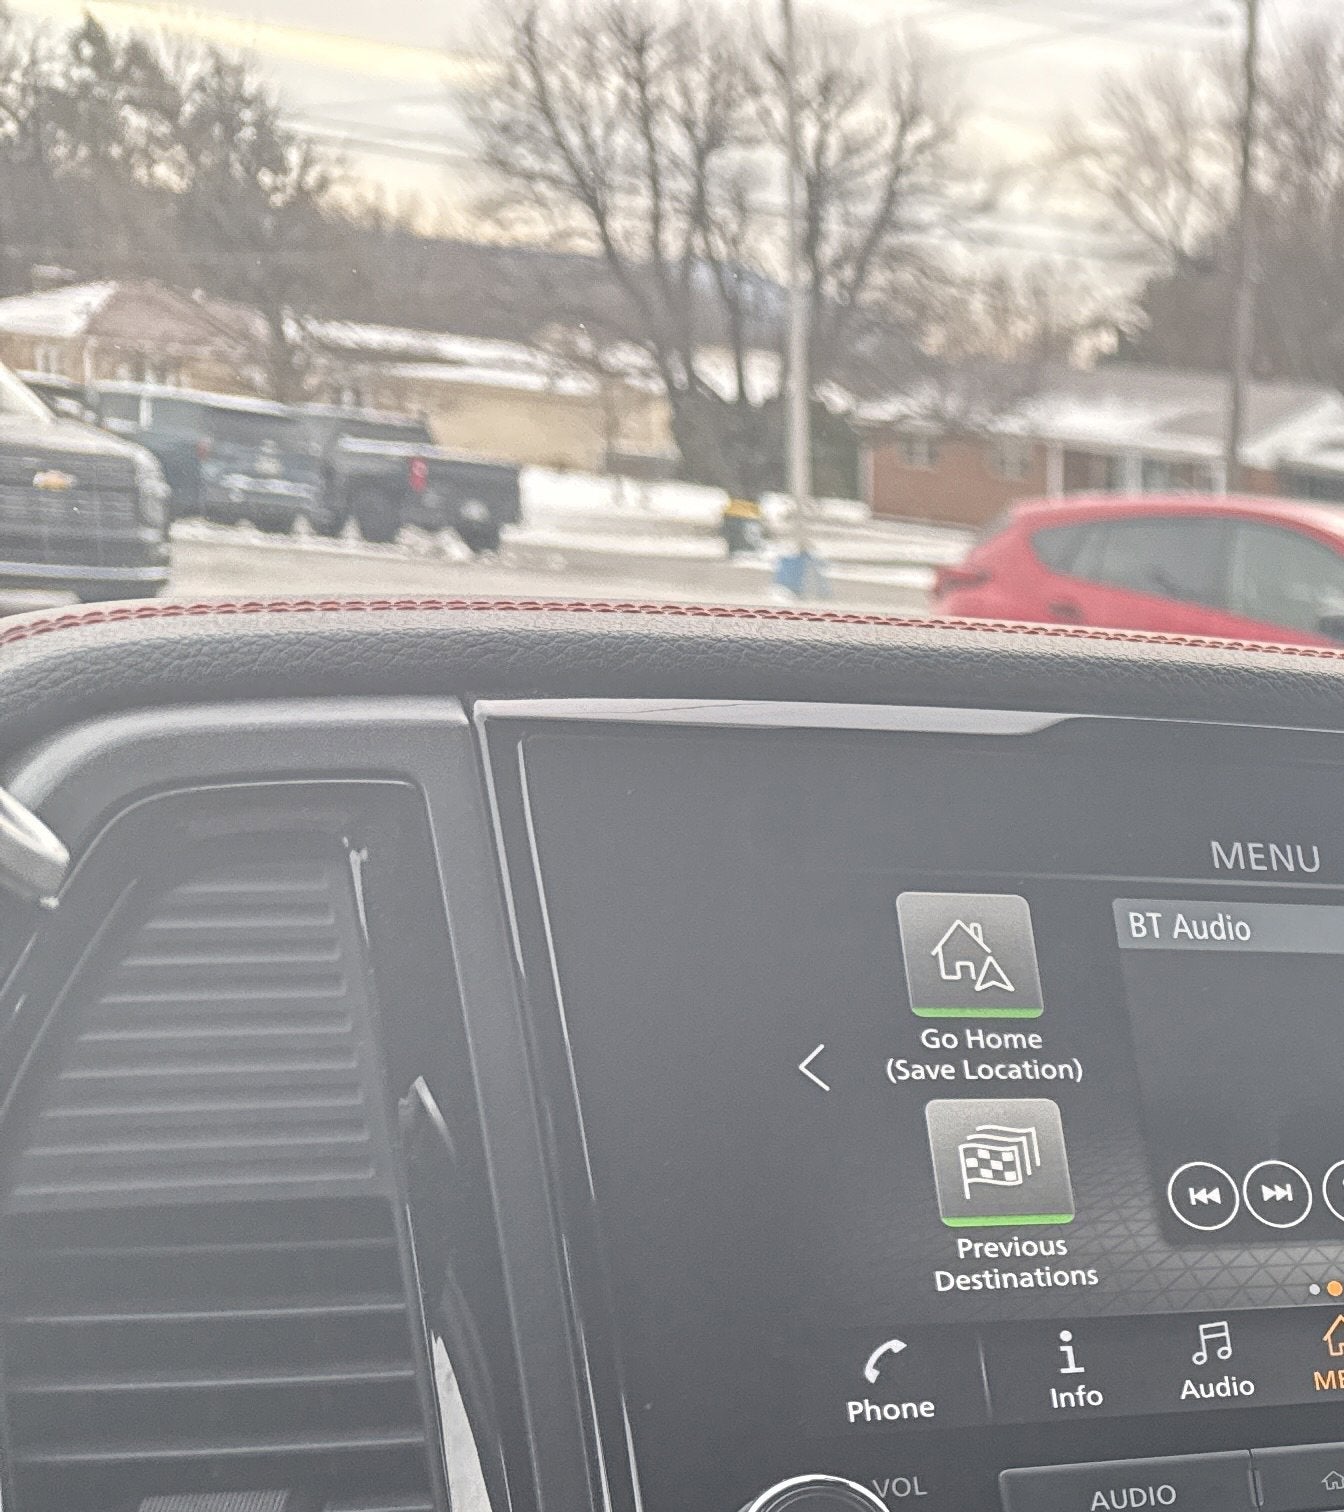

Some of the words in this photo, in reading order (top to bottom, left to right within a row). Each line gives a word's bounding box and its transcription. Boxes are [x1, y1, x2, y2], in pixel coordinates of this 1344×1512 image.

[1210, 840, 1322, 874] MENU
[1128, 912, 1162, 941] BT
[1173, 913, 1252, 944] Audio
[921, 1028, 956, 1052] Go
[965, 1028, 1044, 1051] Home
[886, 1058, 957, 1083] (Save
[963, 1057, 1084, 1083] Location)
[957, 1236, 1068, 1262] Previous
[934, 1266, 1100, 1293] Destinations
[1049, 1385, 1104, 1411] Info
[1180, 1375, 1256, 1400] Audio
[846, 1399, 936, 1424] Phone
[872, 1476, 928, 1499] VOL
[1090, 1483, 1178, 1512] AUDIO
